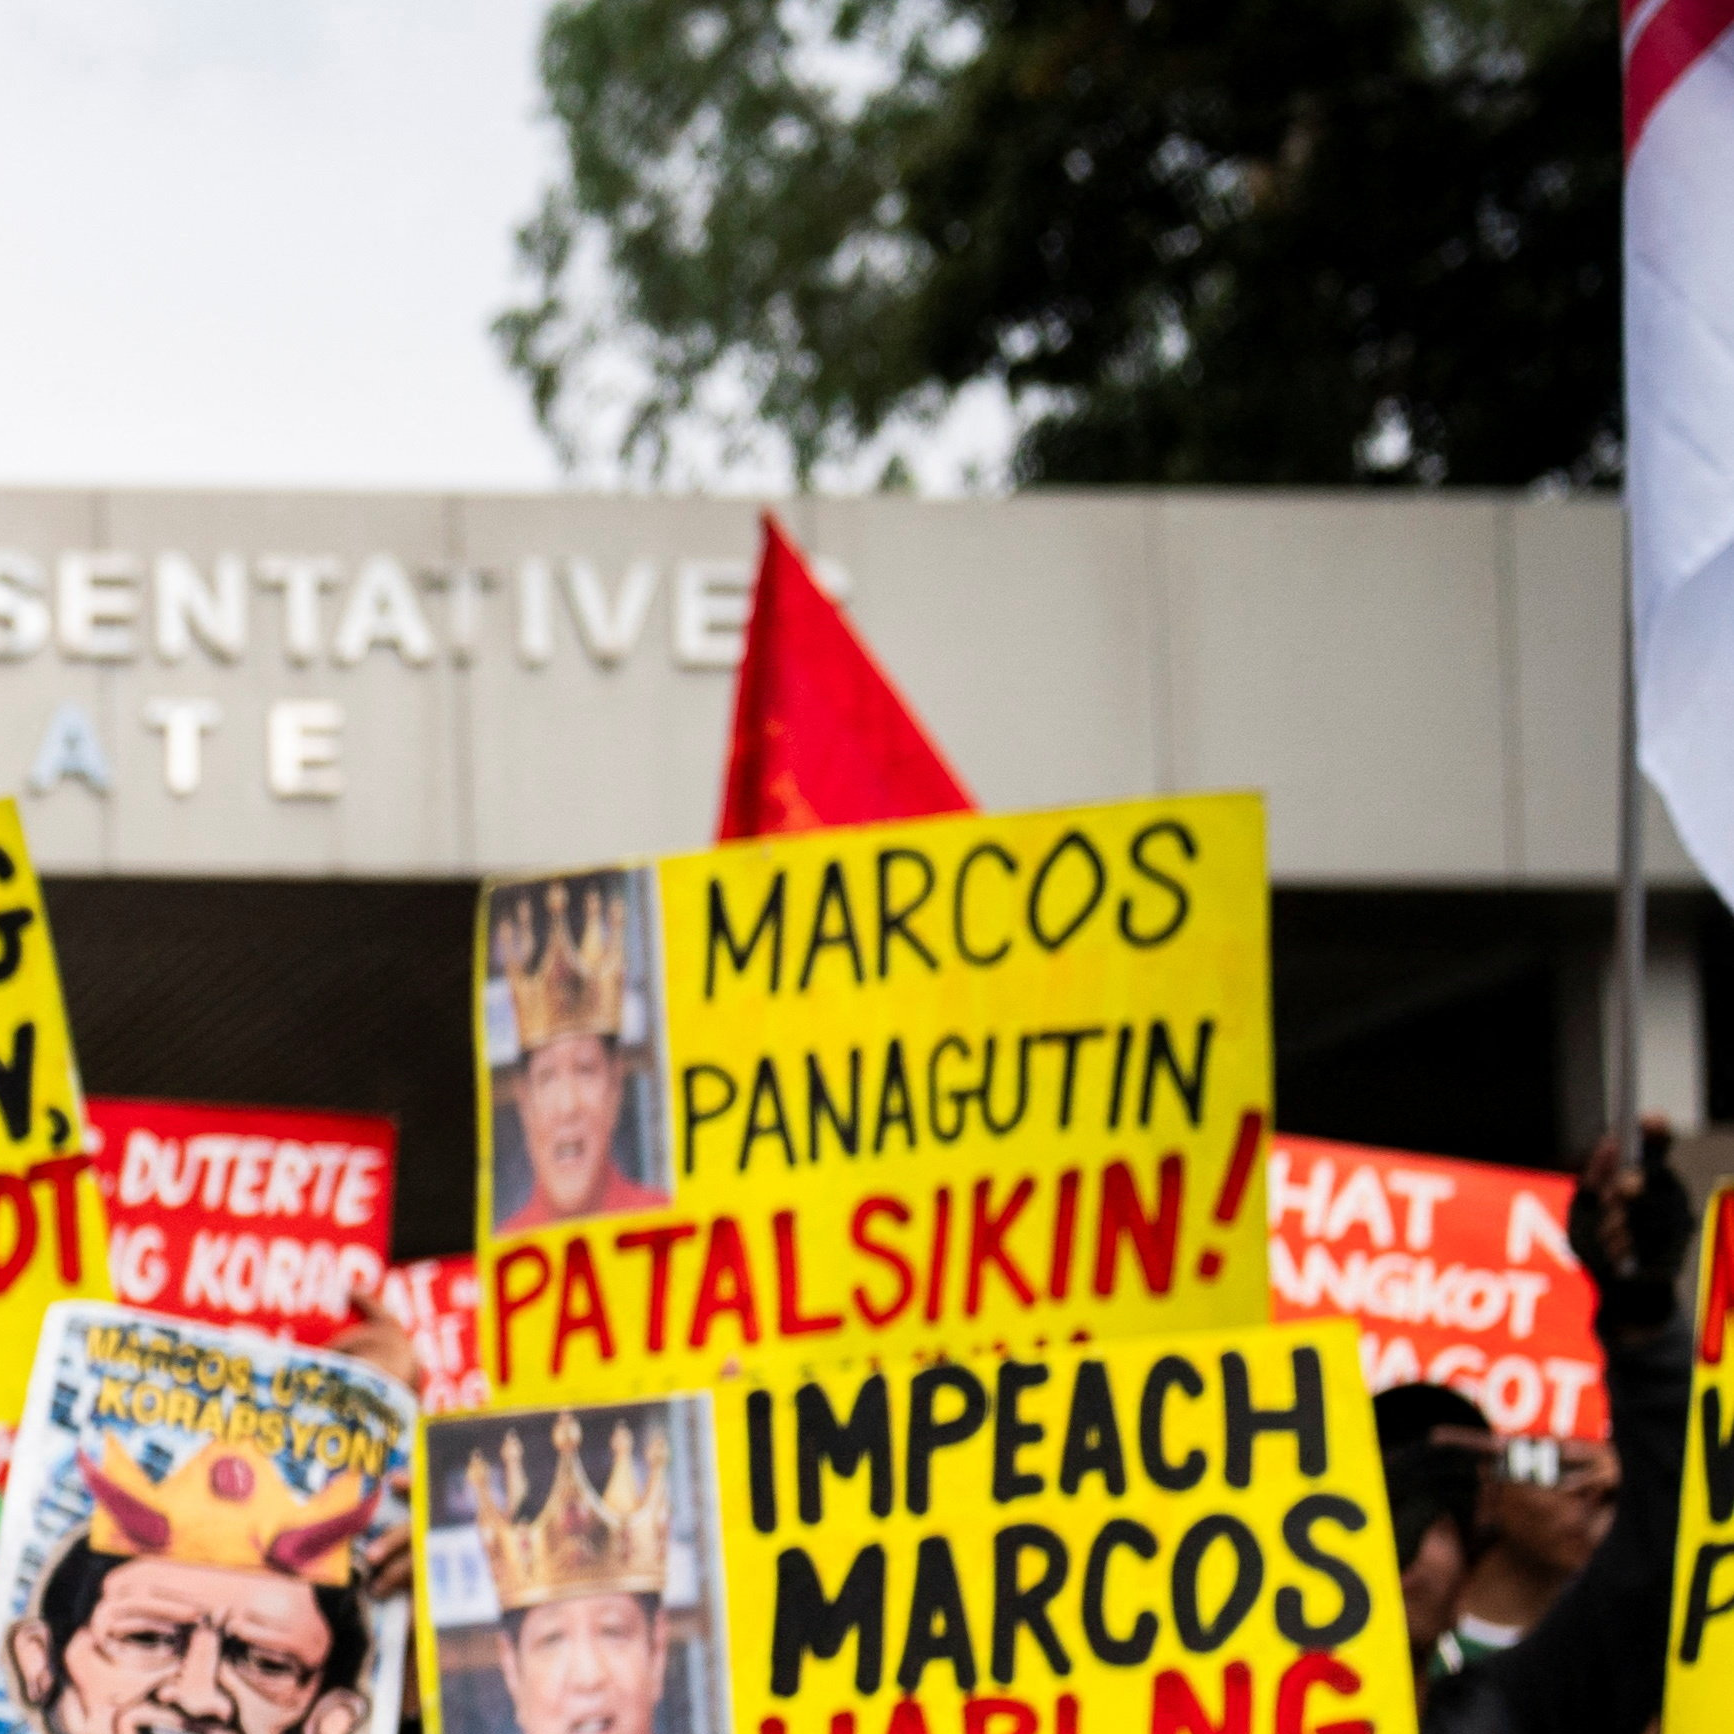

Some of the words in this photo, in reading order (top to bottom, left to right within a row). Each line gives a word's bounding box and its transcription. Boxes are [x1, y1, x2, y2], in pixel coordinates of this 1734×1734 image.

[700, 817, 1199, 1002] MARCOS
[118, 1127, 386, 1228] DUTERTE
[680, 1015, 1218, 1177] PANAGUTIN
[491, 1106, 1265, 1388] PATALSIKIN!
[1268, 1149, 1456, 1251] HAT
[745, 1345, 1329, 1534] IMPEACH
[769, 1494, 1372, 1698] MARCOS
